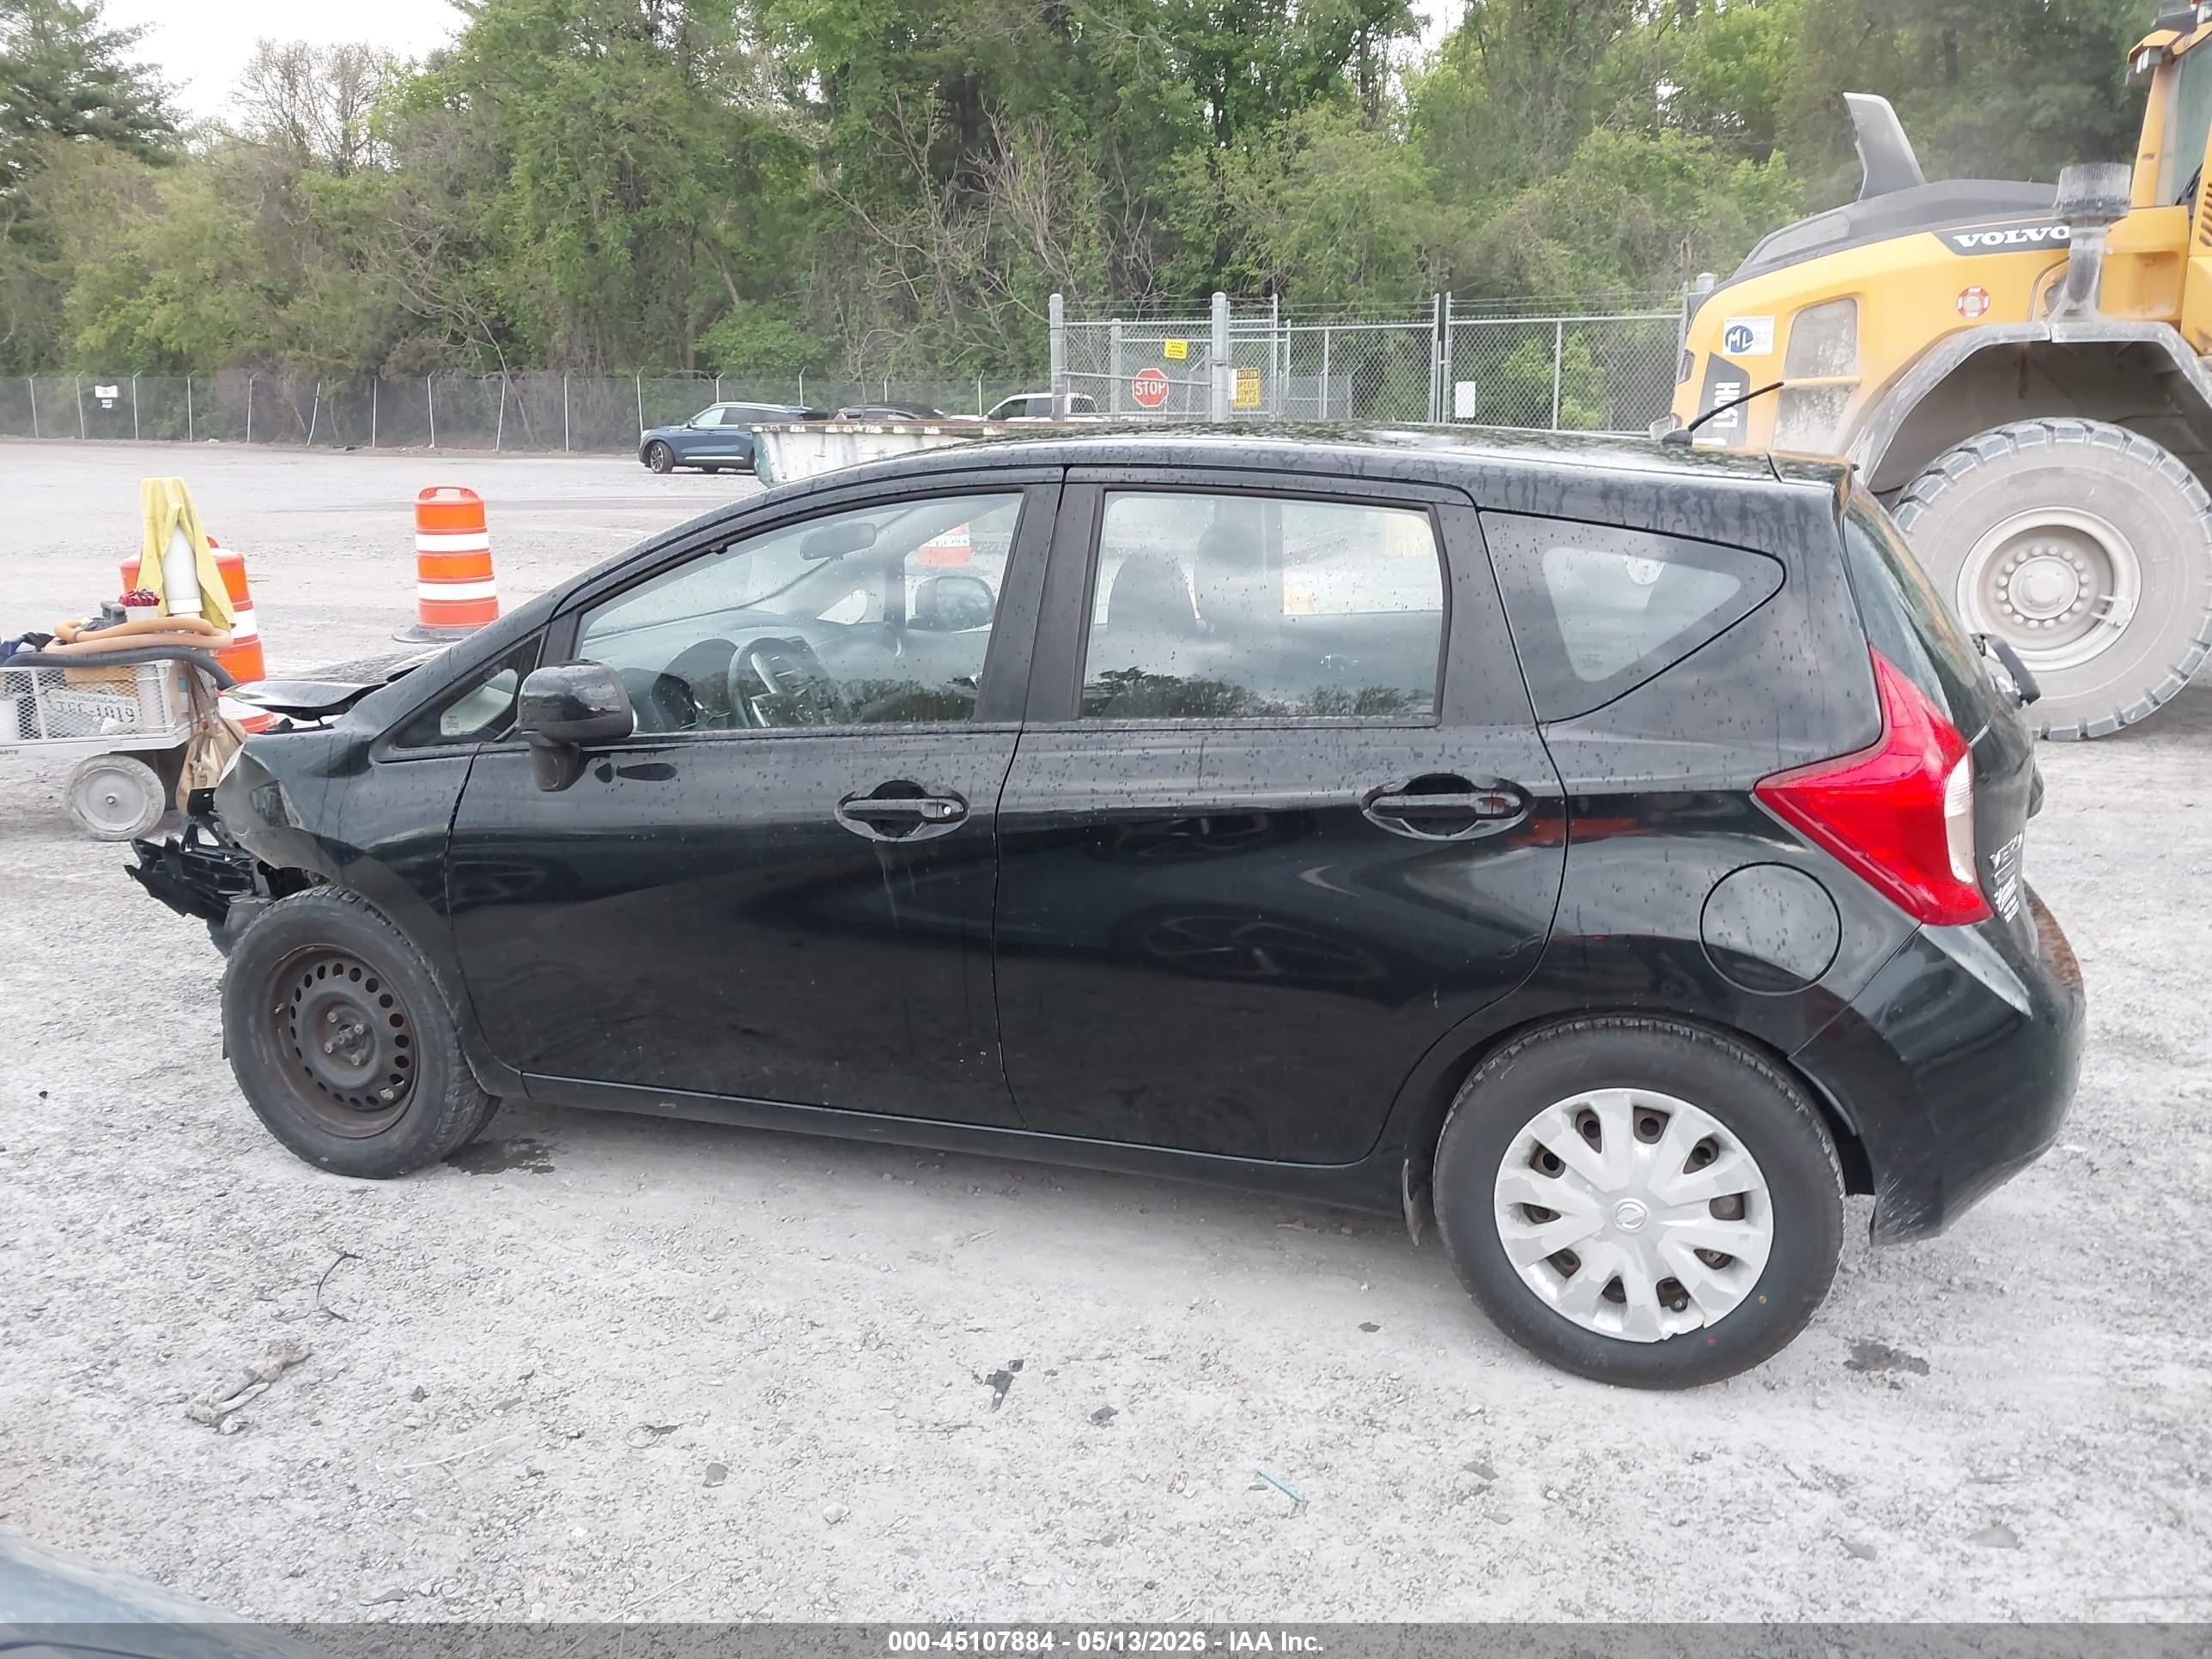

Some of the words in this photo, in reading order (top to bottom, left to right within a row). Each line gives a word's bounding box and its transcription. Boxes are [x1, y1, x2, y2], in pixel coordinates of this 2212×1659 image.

[1953, 225, 2070, 248] VOLVO
[1728, 328, 1753, 352] ML
[1135, 380, 1166, 396] STOP
